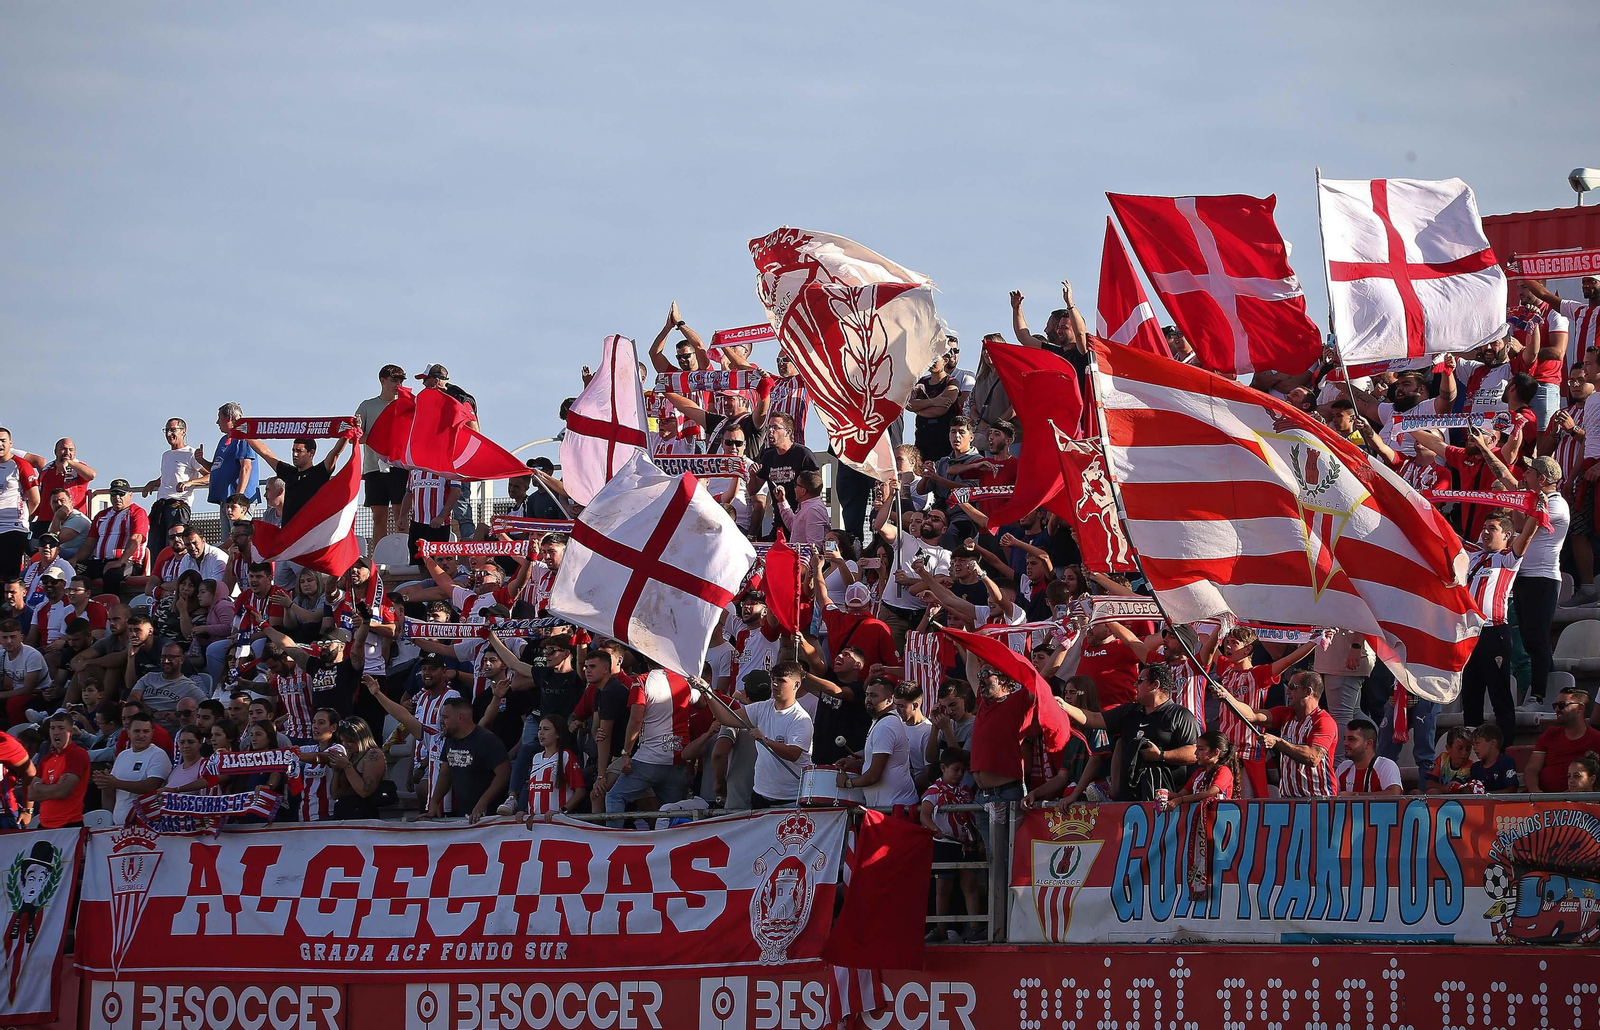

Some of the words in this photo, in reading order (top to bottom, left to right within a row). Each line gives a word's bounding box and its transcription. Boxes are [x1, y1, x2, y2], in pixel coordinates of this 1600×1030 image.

[1522, 255, 1591, 274] ALGECIRAS
[256, 421, 307, 435] ALGECIRAS
[306, 427, 329, 435] FUTBOL
[654, 458, 706, 476] GECIRAS
[708, 458, 722, 474] CF
[972, 485, 1015, 496] ALGEC
[427, 624, 457, 637] VENCER
[458, 624, 472, 637] POR
[221, 750, 292, 769] ALGECIRAS
[165, 793, 229, 812] ALGECIRAS
[232, 793, 250, 811] CF
[1520, 813, 1542, 837] LOS
[1543, 808, 1600, 843] EXCURSION
[170, 835, 731, 939] ALGECIRAS
[299, 943, 374, 962] GRADA
[386, 943, 430, 962] ACF
[440, 942, 514, 962] FONDO
[525, 942, 569, 961] SUR
[142, 985, 342, 1030] BESOCCER
[457, 982, 664, 1030] BESOCCER
[755, 980, 977, 1030] BESCCER
